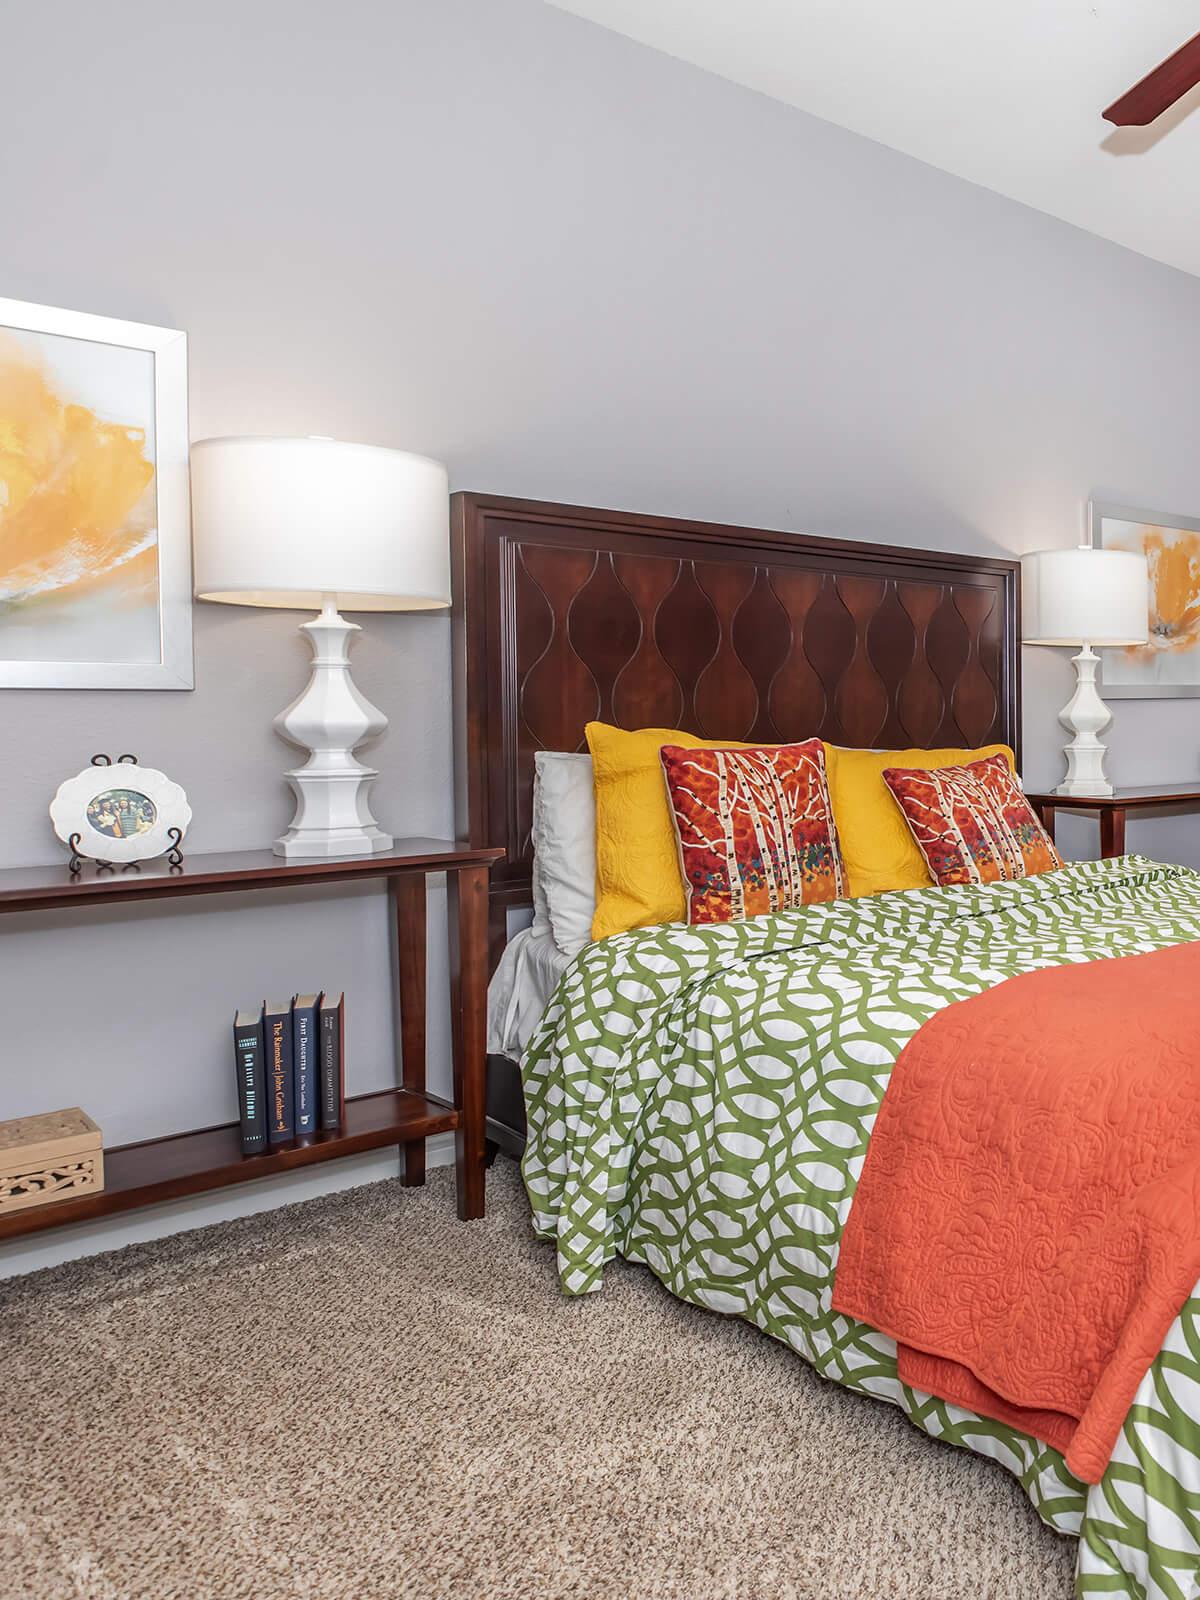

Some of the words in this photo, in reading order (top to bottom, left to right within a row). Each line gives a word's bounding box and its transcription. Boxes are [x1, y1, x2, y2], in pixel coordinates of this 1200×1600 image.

[273, 1021, 283, 1036] The
[274, 1036, 284, 1071] Rainmaker
[273, 1075, 285, 1091] John
[275, 1091, 285, 1120] Grisham
